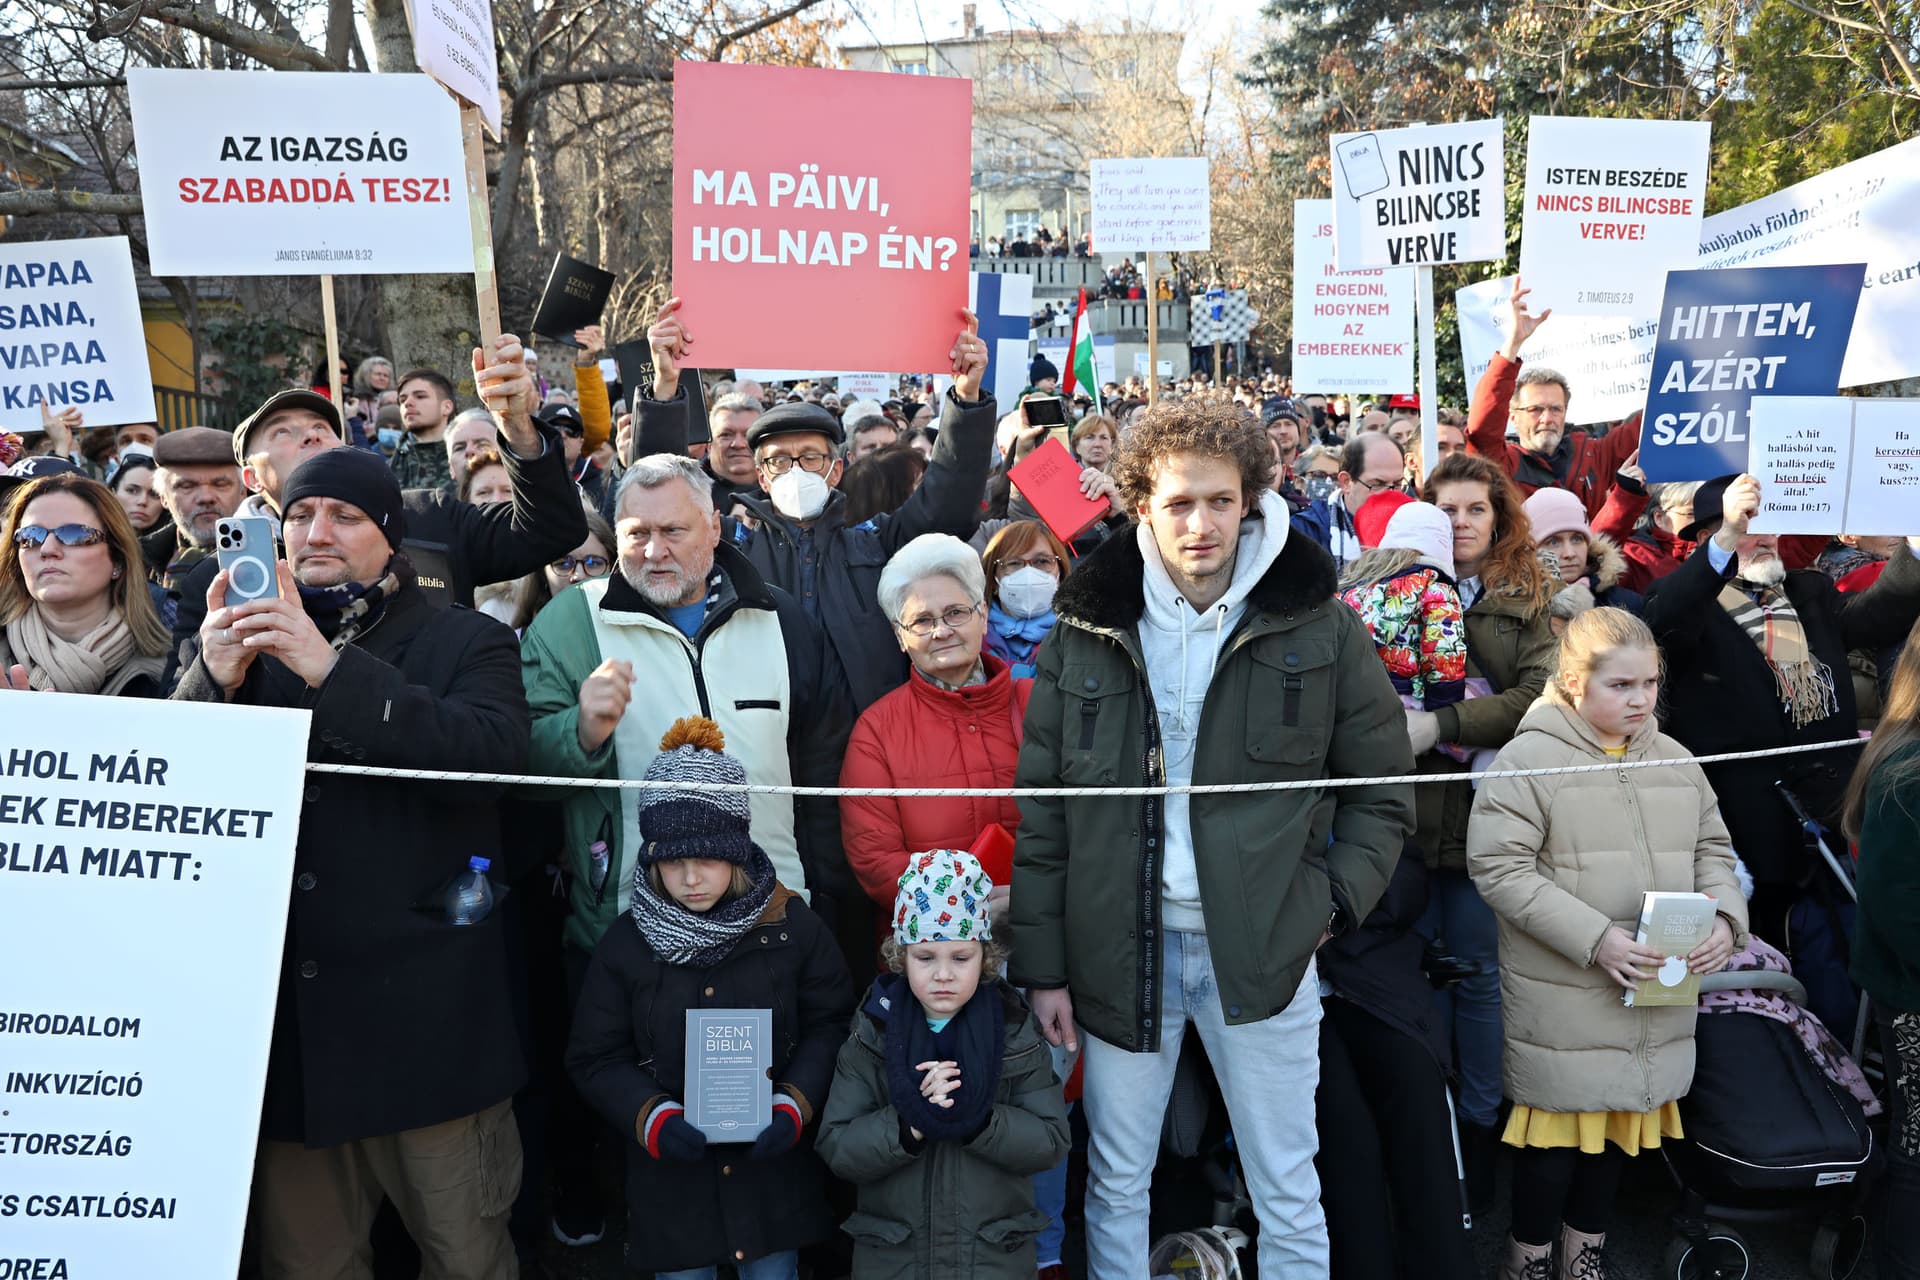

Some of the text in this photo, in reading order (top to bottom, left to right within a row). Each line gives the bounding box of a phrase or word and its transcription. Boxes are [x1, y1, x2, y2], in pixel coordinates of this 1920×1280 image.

[219, 132, 408, 163] AZ IGAZSÁG
[1399, 142, 1485, 187] NINCS
[1546, 166, 1688, 189] ISTEN BESZÉDE
[178, 172, 451, 203] SZABADDÁ TESZ!
[692, 163, 890, 217] MA PÄIVI,
[1376, 188, 1481, 227] BILINCSBE
[1536, 194, 1693, 216] NINCS BILINCSBE
[1579, 222, 1646, 241] VERVE!
[692, 225, 958, 272] HOLNAP ÉN?
[1387, 232, 1457, 266] VERVE
[0, 259, 93, 289] APAA
[1316, 283, 1388, 298] ENGEDNI,
[1314, 303, 1390, 317] HOGYNEM
[1669, 301, 1816, 341] HITTEM,
[1343, 324, 1364, 336] AZ
[1658, 350, 1787, 394] AZÉRT
[2, 378, 115, 410] KANSA
[1652, 403, 1751, 446] SZÓL
[1795, 430, 1804, 439] A
[1806, 429, 1821, 439] hit
[1895, 431, 1910, 440] Ha
[1767, 443, 1813, 454] hallásból
[1767, 458, 1836, 471] a hallás pedig
[1775, 473, 1799, 483] Isten
[1764, 502, 1831, 513] (Róma 10:17)
[418, 576, 445, 589] Biblia
[0, 748, 168, 787] HOL MÁR
[55, 797, 273, 840] EMBEREKET
[80, 844, 203, 882] MIATT:
[706, 1026, 753, 1038] SZENT
[706, 1039, 753, 1052] BIBLIA
[5, 1070, 143, 1098] INKVIZÍCIÓ
[25, 1192, 177, 1219] CSATLÓSAI
